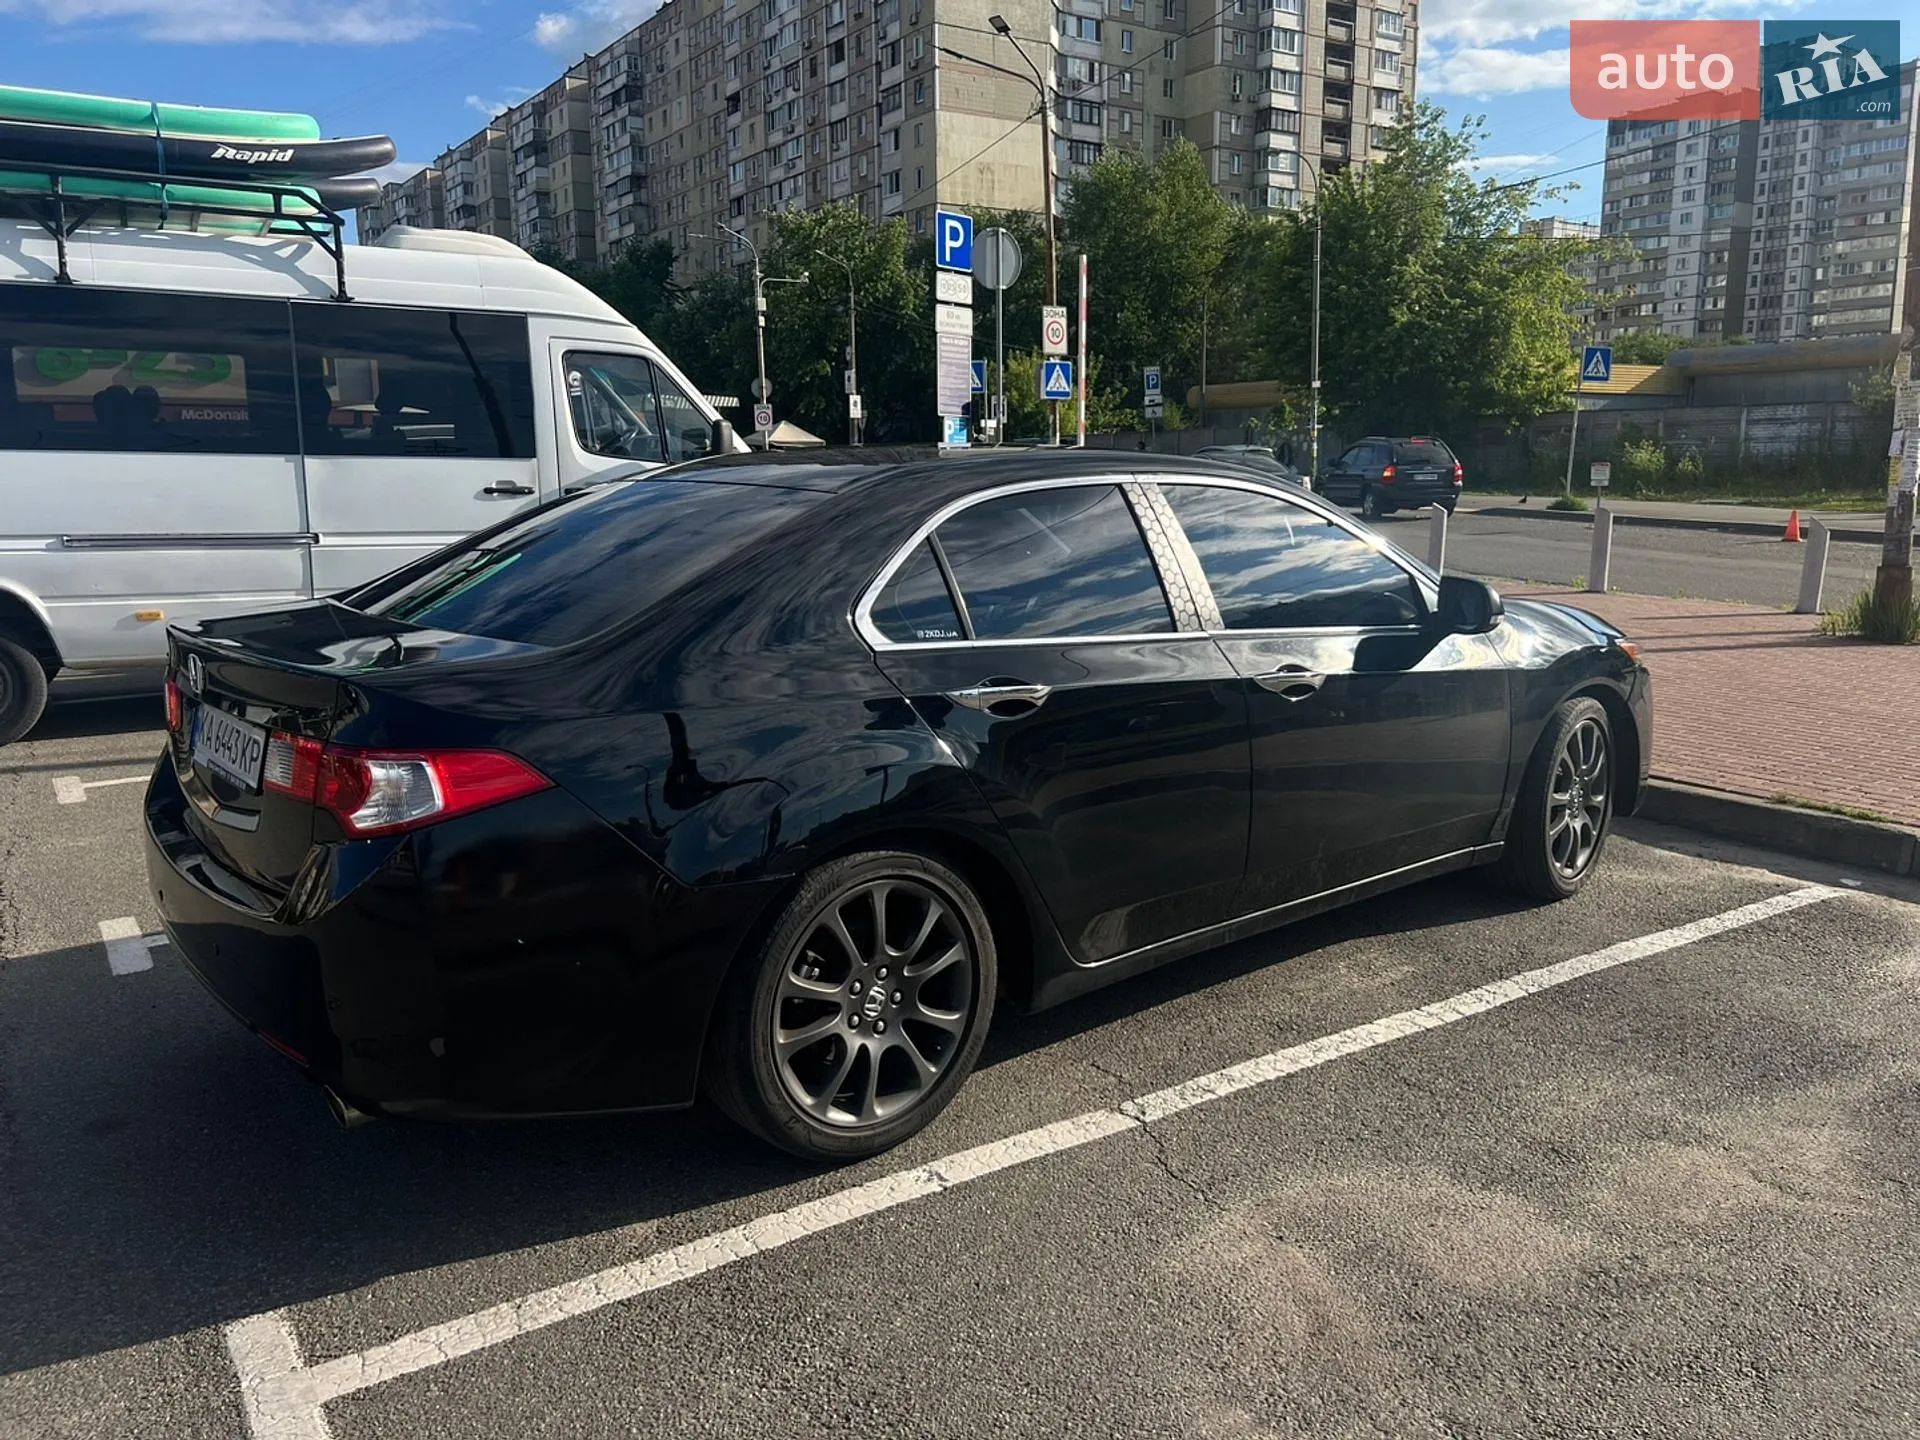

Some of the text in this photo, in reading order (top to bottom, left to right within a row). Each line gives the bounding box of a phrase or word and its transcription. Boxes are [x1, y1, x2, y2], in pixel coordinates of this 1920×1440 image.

[211, 143, 294, 164] Rapid
[945, 219, 965, 262] P
[1051, 327, 1061, 339] 10
[1149, 374, 1157, 389] P
[214, 720, 241, 765] 6443
